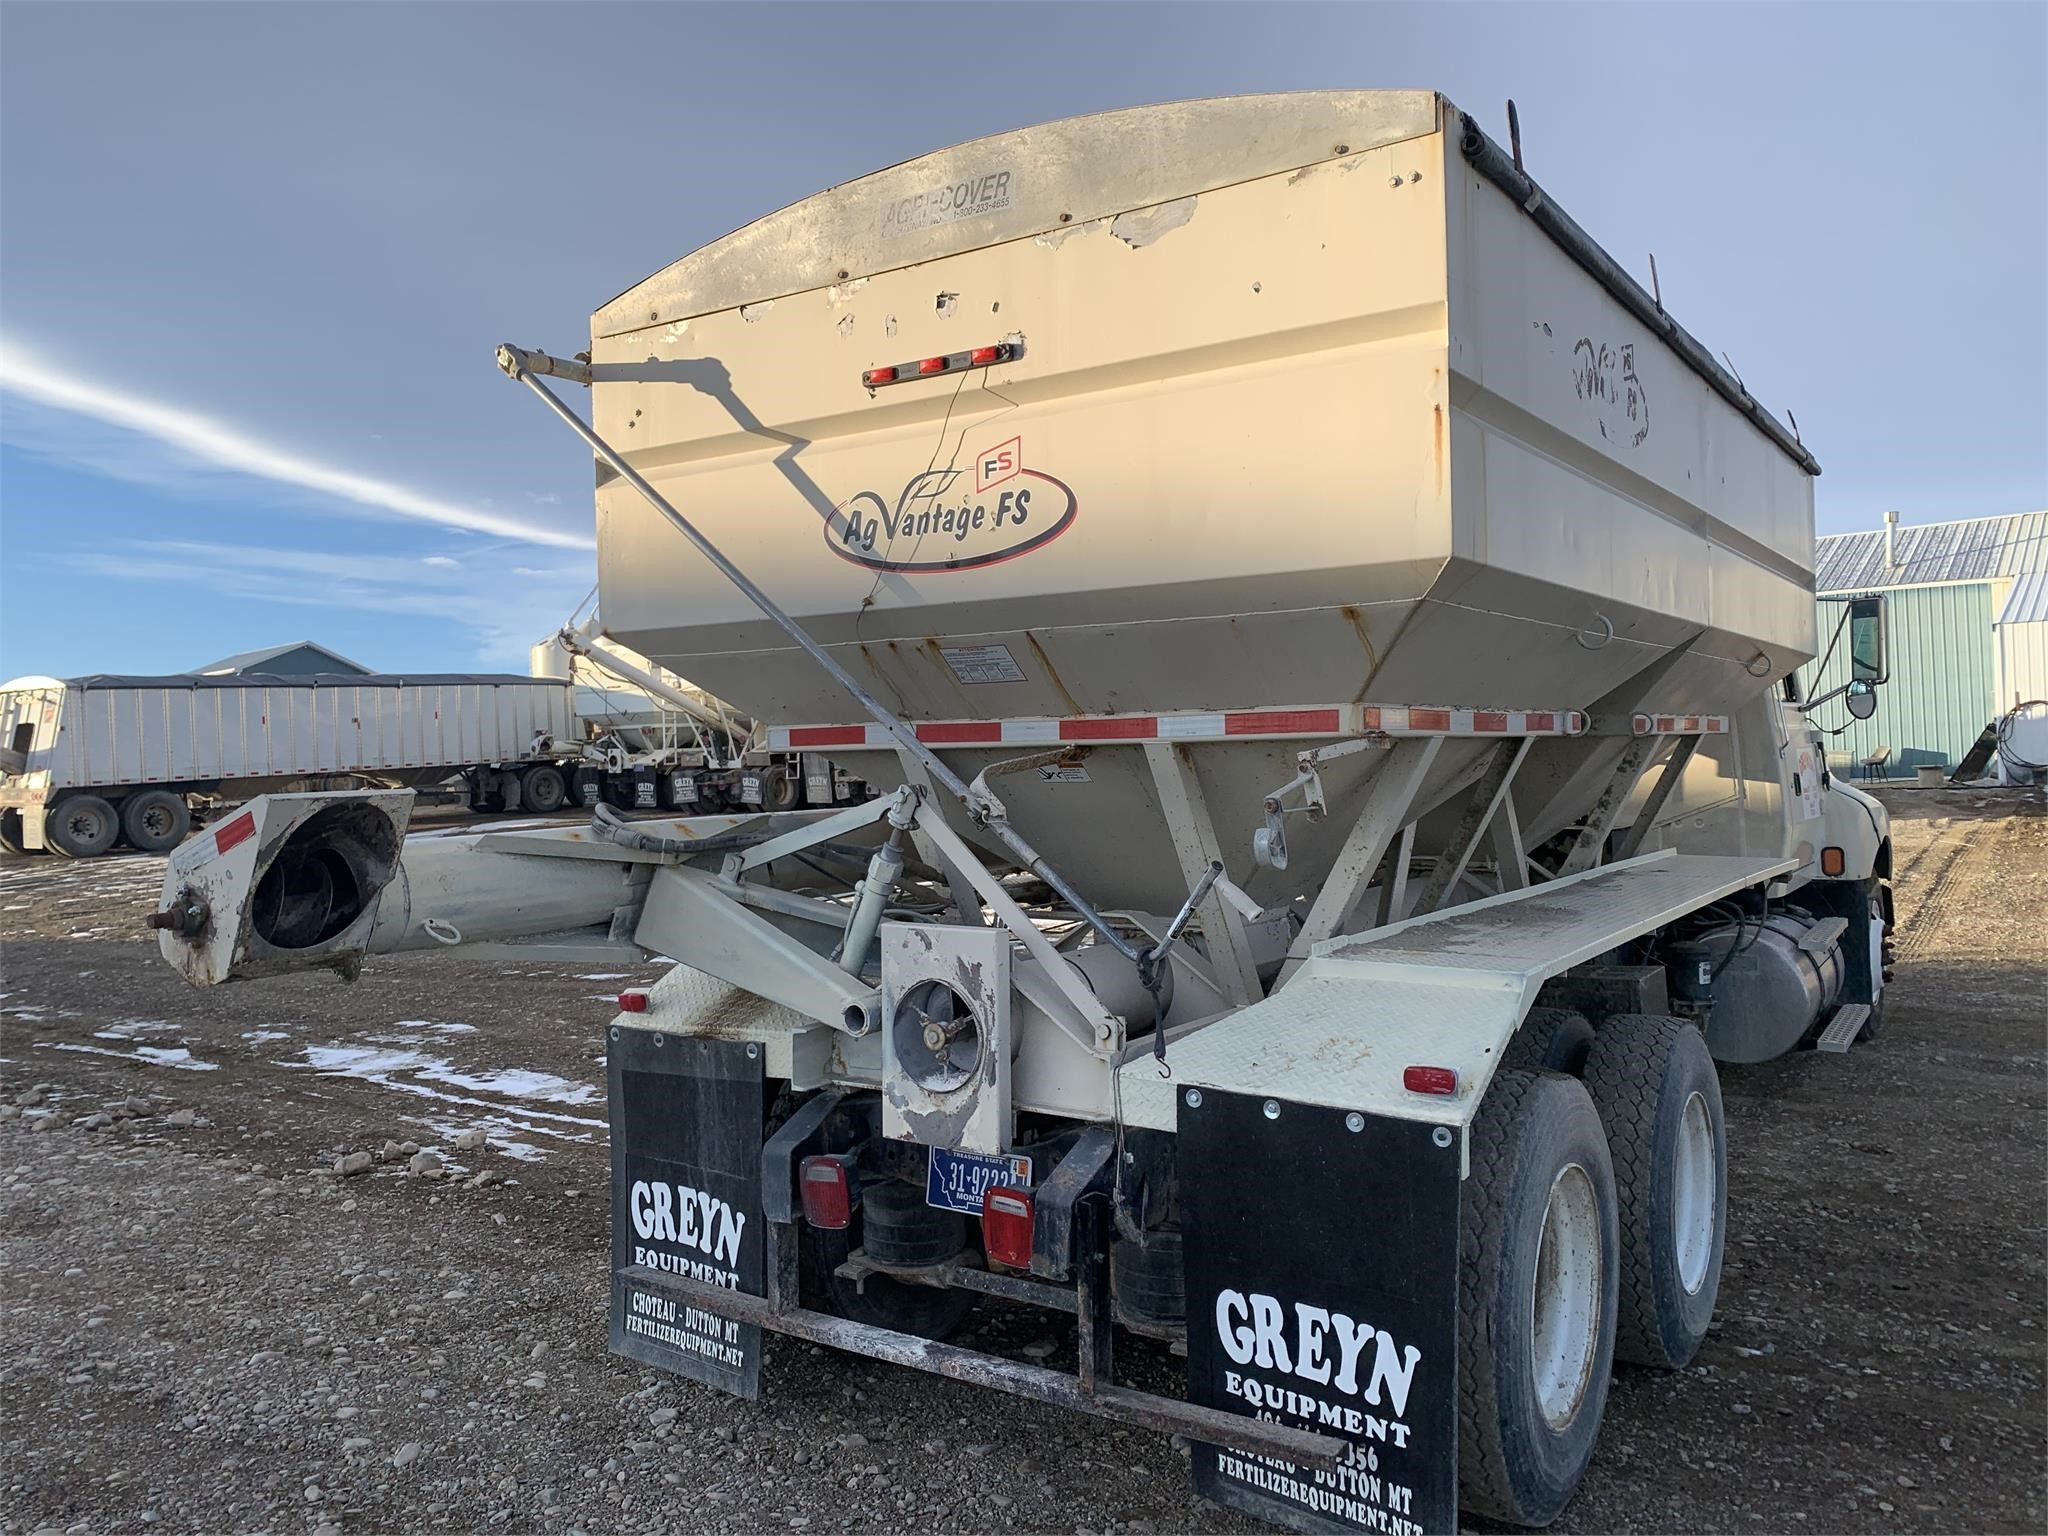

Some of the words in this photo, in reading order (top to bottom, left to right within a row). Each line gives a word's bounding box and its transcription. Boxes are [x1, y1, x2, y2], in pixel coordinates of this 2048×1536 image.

[984, 451, 1013, 479] FS
[843, 469, 985, 551] AgVantage
[995, 488, 1031, 525] FS
[953, 1152, 983, 1162] TREASURE
[985, 1157, 1003, 1165] STATE
[956, 1192, 984, 1202] MONTA
[631, 1180, 746, 1269] GREYN
[634, 1246, 740, 1291] EQUIPMENT
[626, 1314, 744, 1368] FERTILIZEREQUIPMENT.NET
[632, 1291, 676, 1323] CHOTEAU
[686, 1308, 721, 1338] DUTTON
[724, 1319, 739, 1344] MT
[1216, 1288, 1421, 1418] GREYN
[1225, 1370, 1411, 1449] EQUIPMENT
[1218, 1453, 1423, 1536] FERTILIZEREQUIPMENT.NET
[1388, 1482, 1412, 1516] MT
